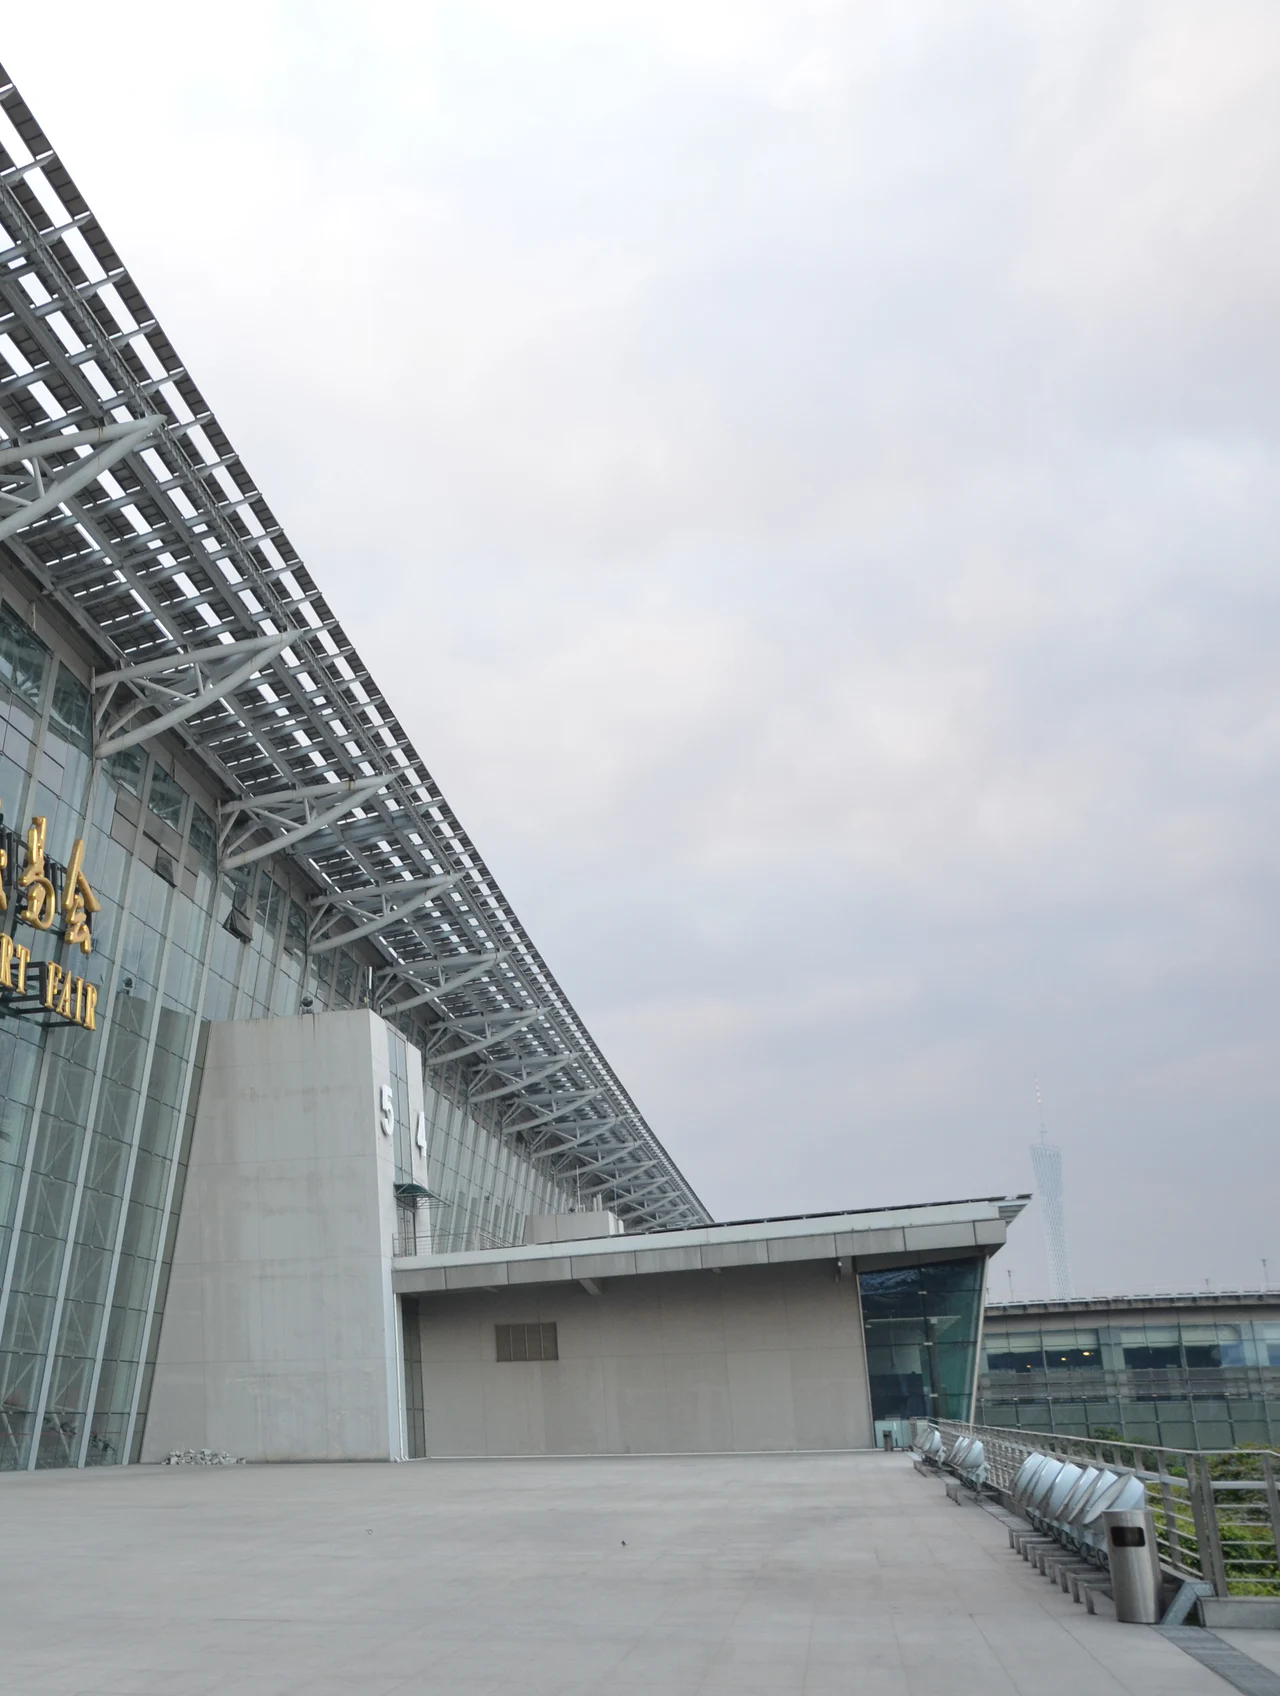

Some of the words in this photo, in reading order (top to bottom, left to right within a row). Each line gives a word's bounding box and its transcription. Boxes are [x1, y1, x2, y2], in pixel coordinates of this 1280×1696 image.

[45, 961, 98, 1031] FAIR
[380, 1084, 394, 1137] 5
[416, 1111, 427, 1159] 4
